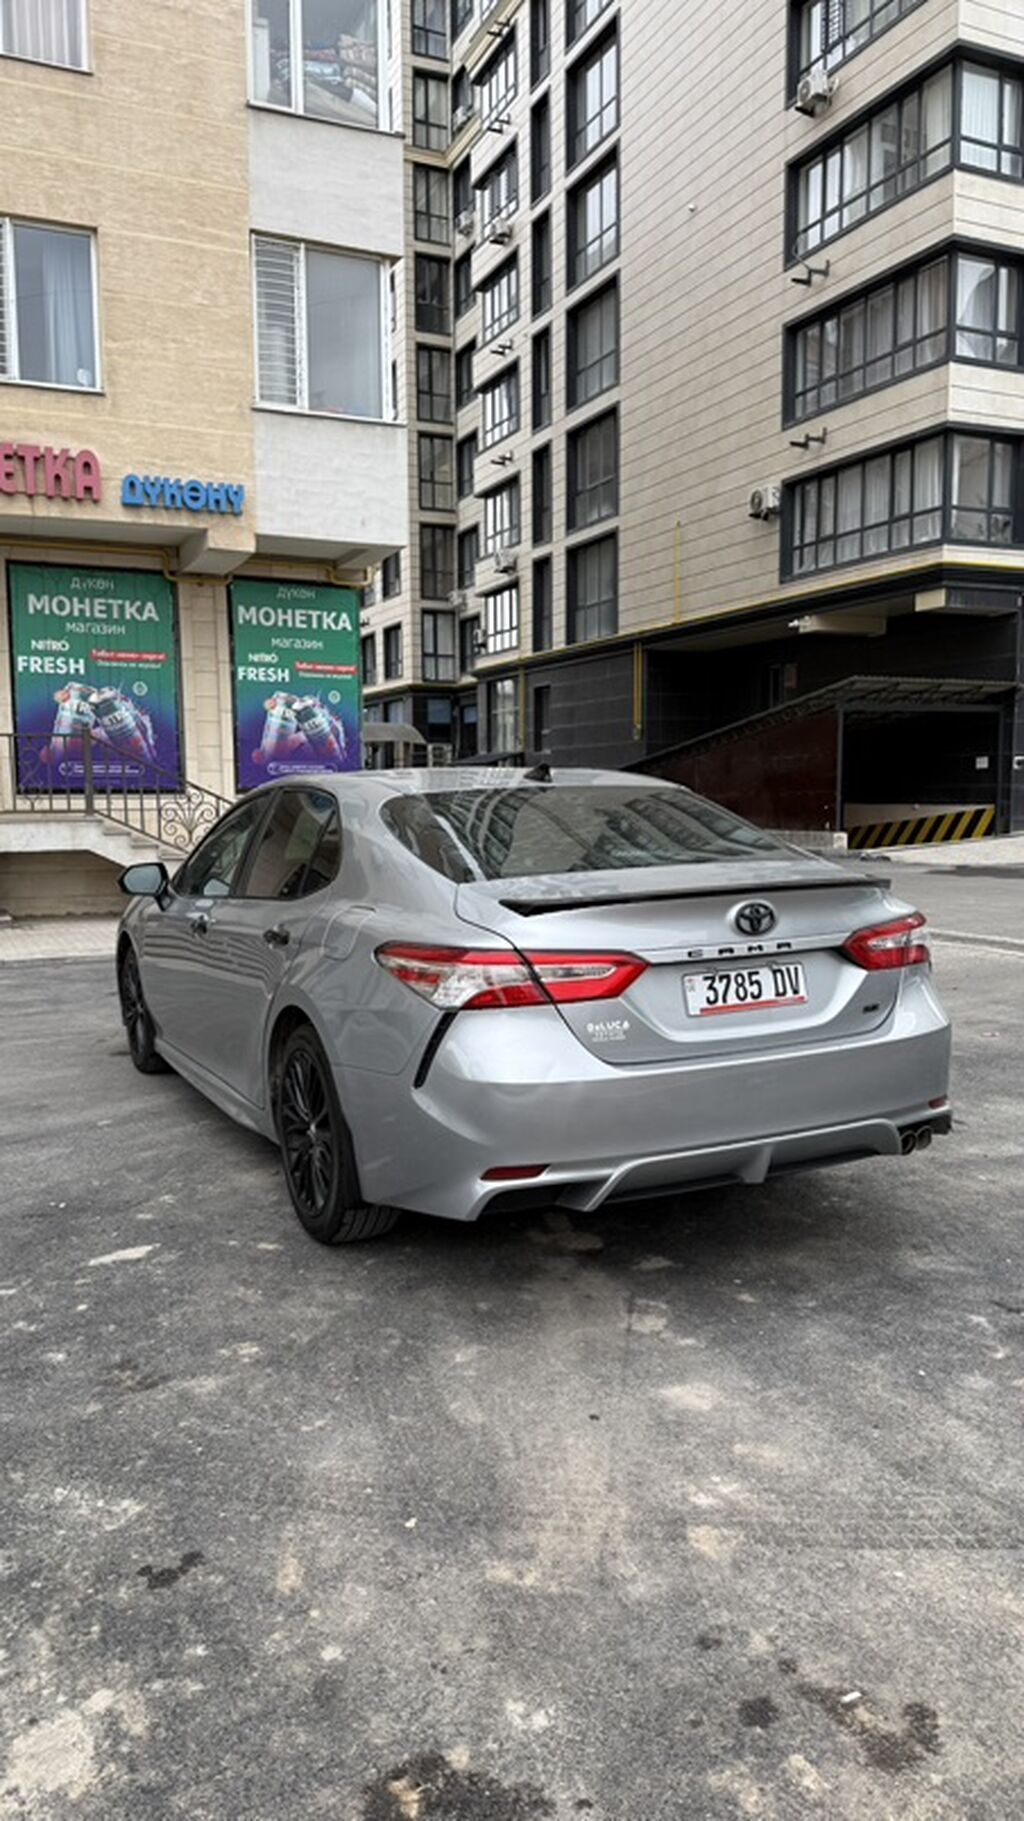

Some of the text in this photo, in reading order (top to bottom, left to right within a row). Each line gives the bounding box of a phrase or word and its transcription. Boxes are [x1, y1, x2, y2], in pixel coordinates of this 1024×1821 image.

[27, 593, 159, 621] МОНЕТКА
[65, 621, 126, 635] магазин
[237, 605, 352, 631] МОНЕТКА
[271, 637, 323, 650] магазин
[17, 655, 85, 675] FRESH
[237, 666, 290, 682] FRESH
[703, 966, 800, 1005] 3785 DV
